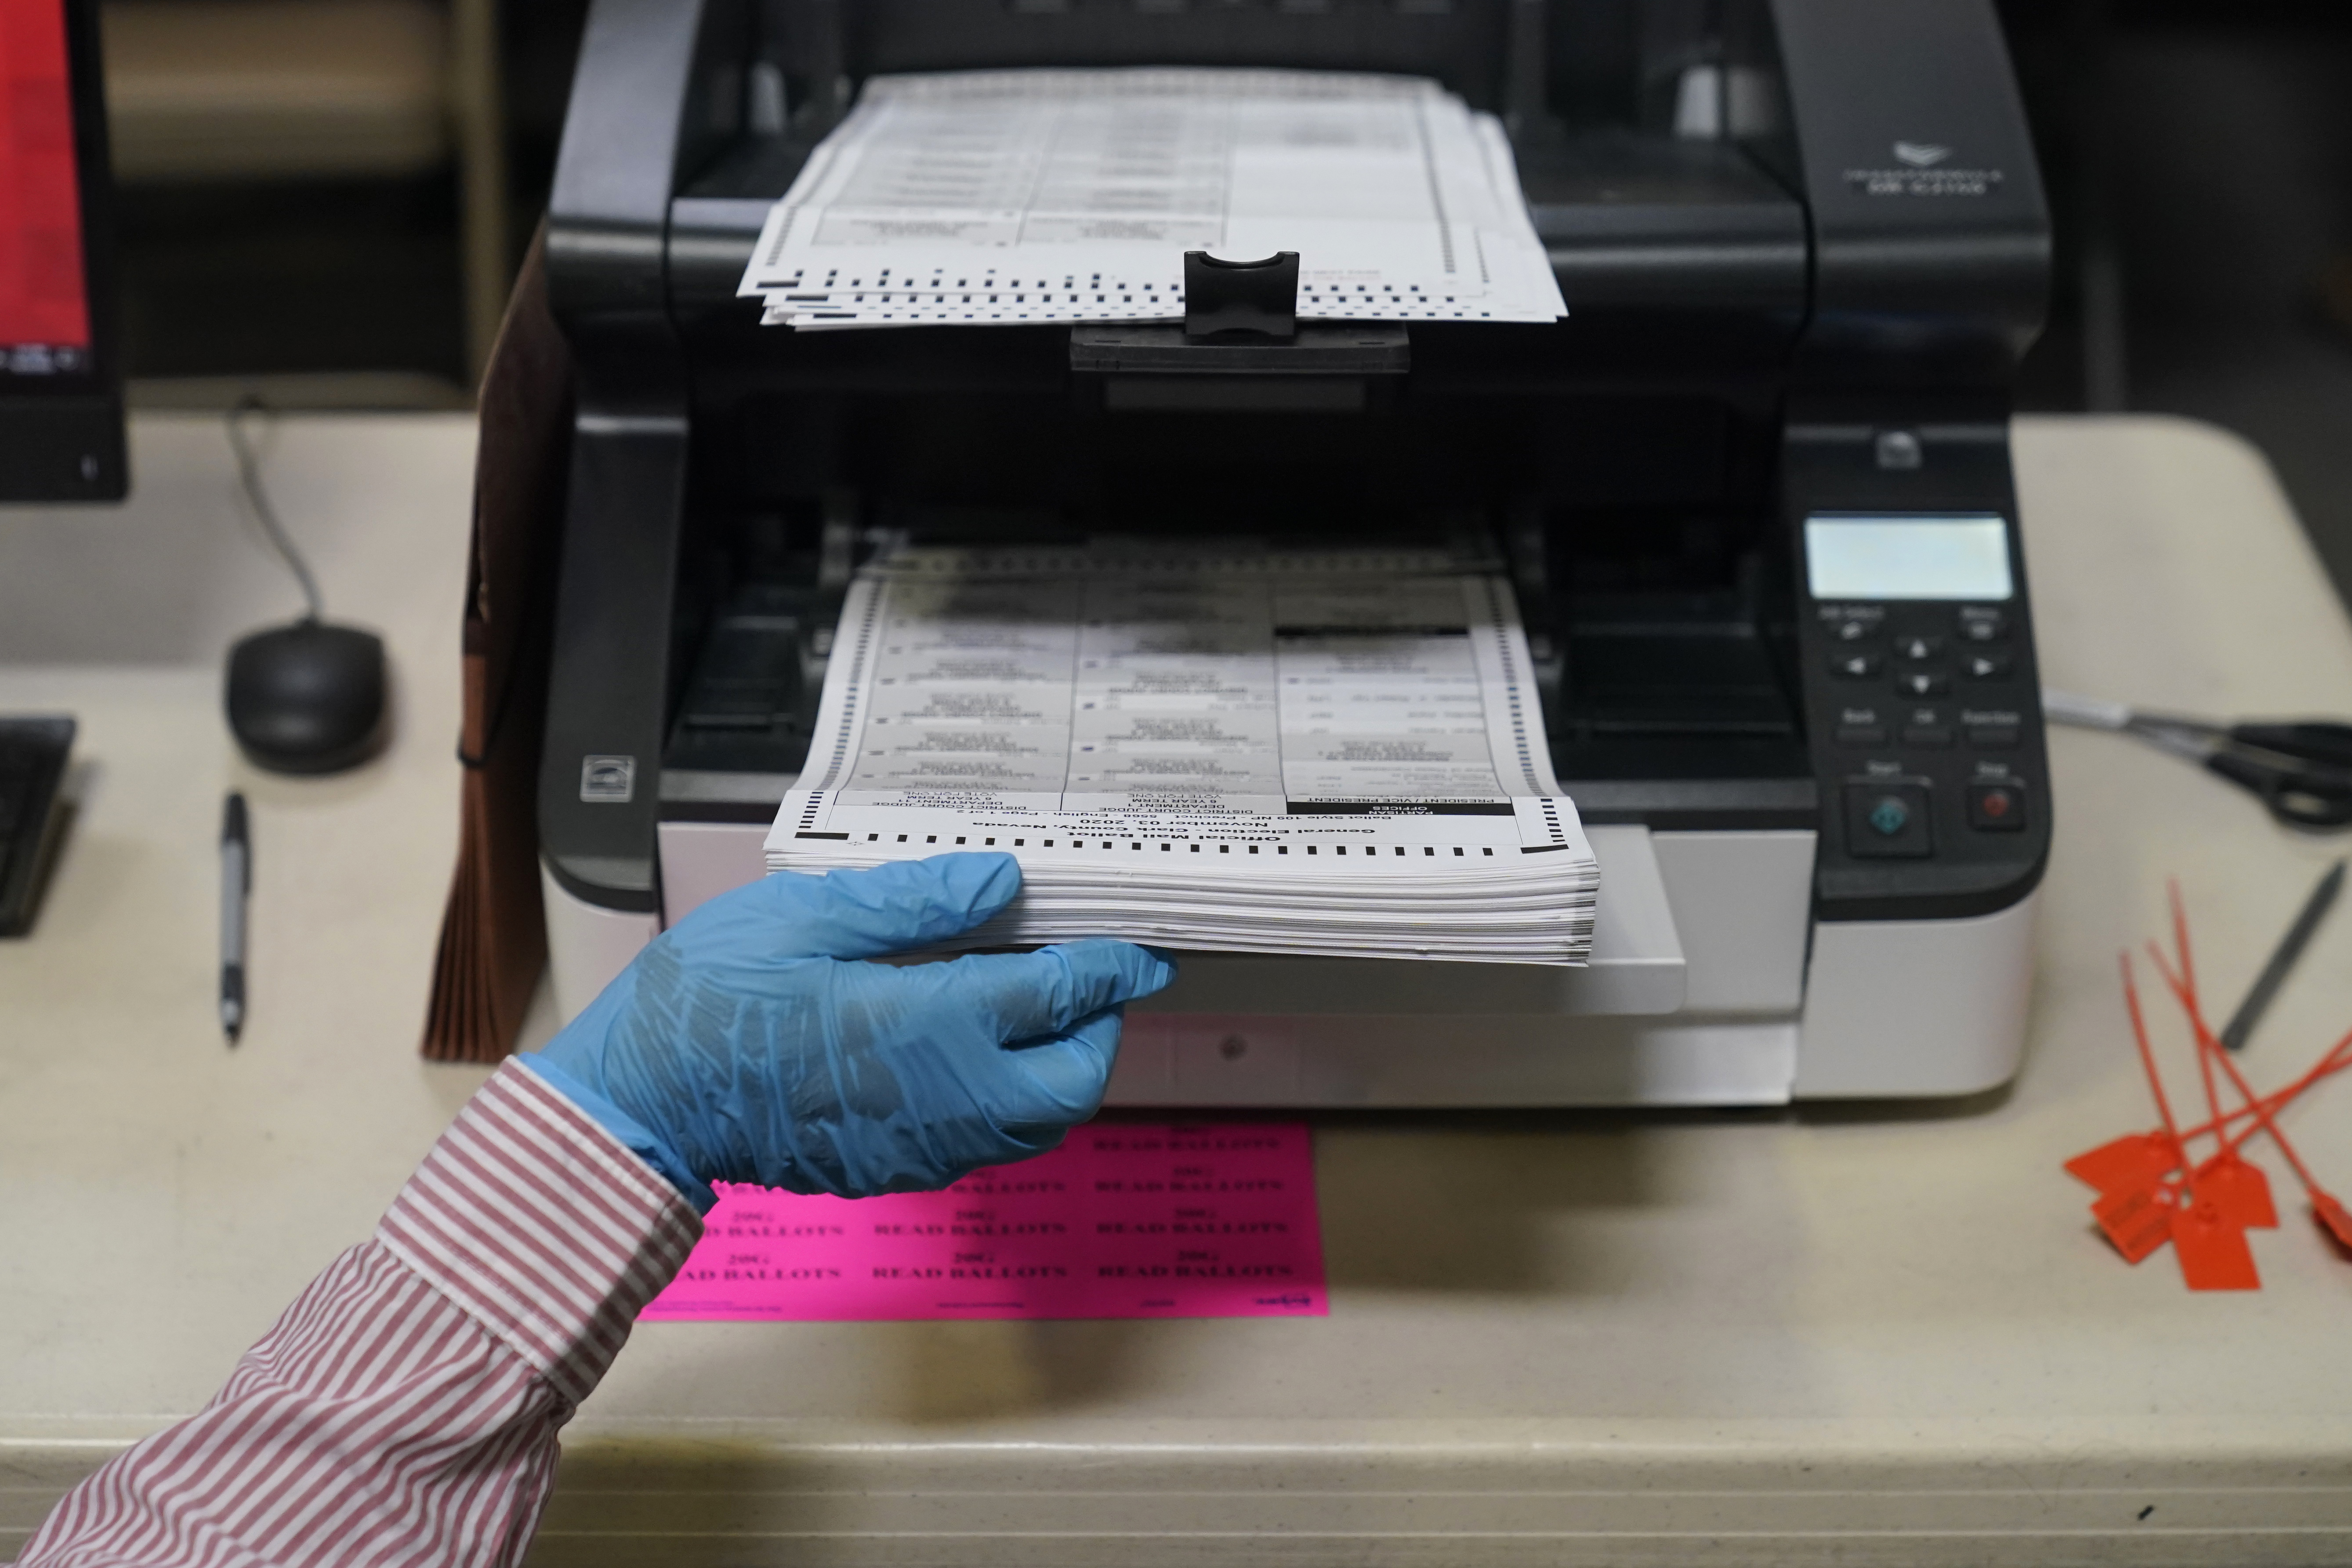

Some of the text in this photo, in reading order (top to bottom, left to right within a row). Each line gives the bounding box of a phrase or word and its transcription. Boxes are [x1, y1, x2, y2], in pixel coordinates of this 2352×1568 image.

[1096, 1180, 1283, 1192] READ BALLOTS
[728, 1227, 843, 1236] BALLOTS
[875, 1224, 1065, 1235] READ BALLOTS
[1097, 1222, 1287, 1234] READ BALLOTS
[685, 1269, 841, 1280] AD BALLOTS
[873, 1267, 1066, 1278] READ BALLOTS
[1098, 1265, 1292, 1277] READ BALLOTS
